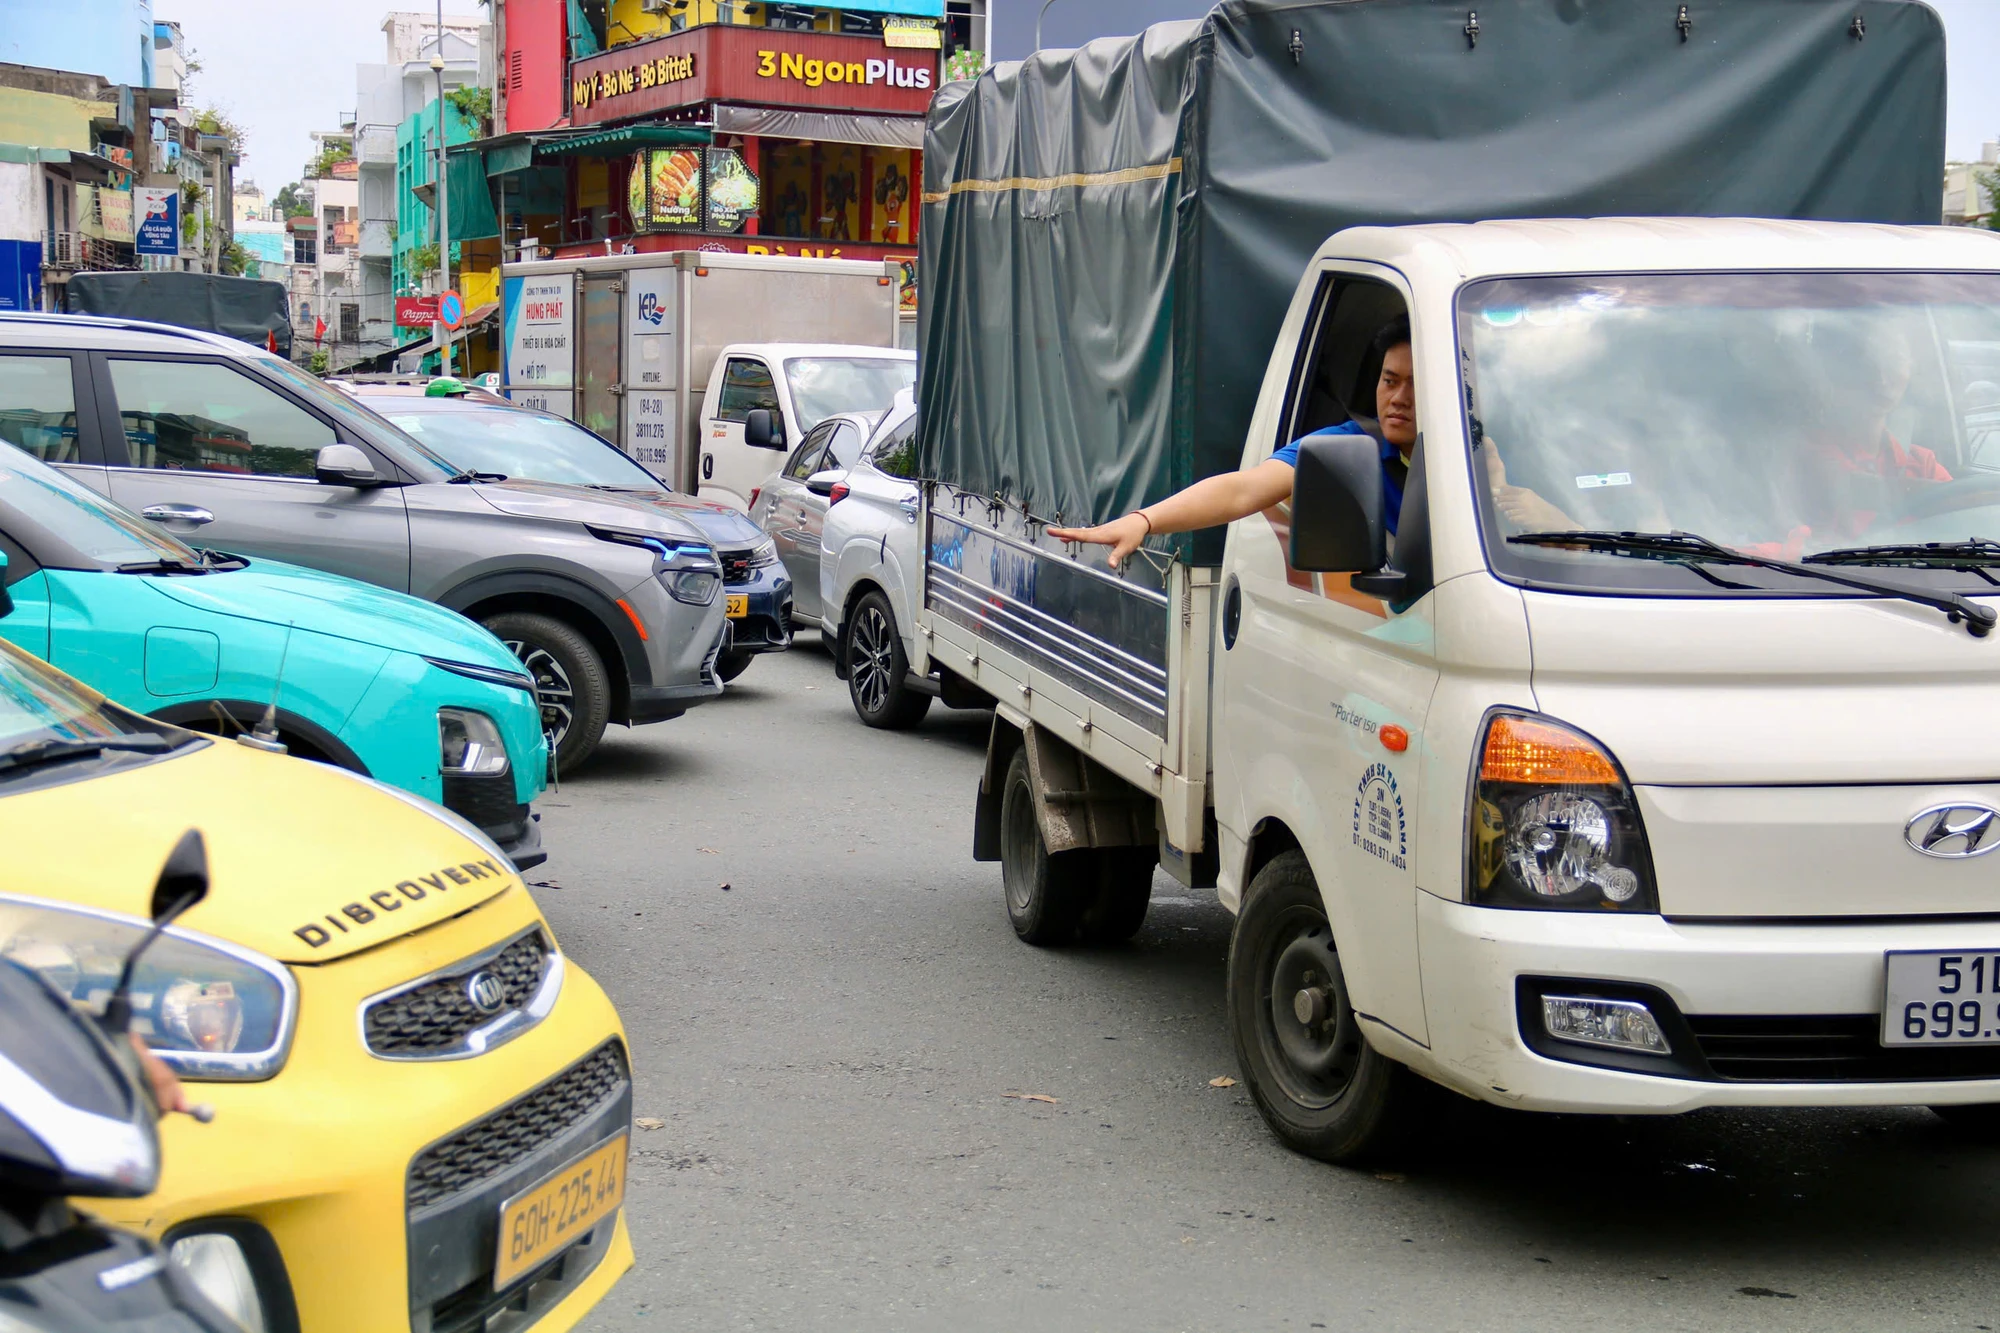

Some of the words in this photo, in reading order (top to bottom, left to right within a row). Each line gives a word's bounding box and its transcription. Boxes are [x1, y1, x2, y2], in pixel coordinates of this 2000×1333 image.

[603, 71, 618, 98] Bò
[619, 66, 634, 94] Né
[641, 60, 656, 89] Bò
[657, 53, 693, 85] Bittet
[652, 214, 682, 224] Hoàng
[683, 214, 698, 223] Gia
[718, 220, 732, 228] Cay
[546, 297, 563, 319] PHÁT
[640, 398, 663, 416] (84-28)
[635, 423, 665, 438] 38111.275
[1376, 762, 1386, 778] SX
[1363, 837, 1407, 871] 0283.971.4034
[293, 859, 502, 948] DISCOVERY
[1903, 1000, 2000, 1039] 699.
[511, 1152, 617, 1263] 60H-225.44
